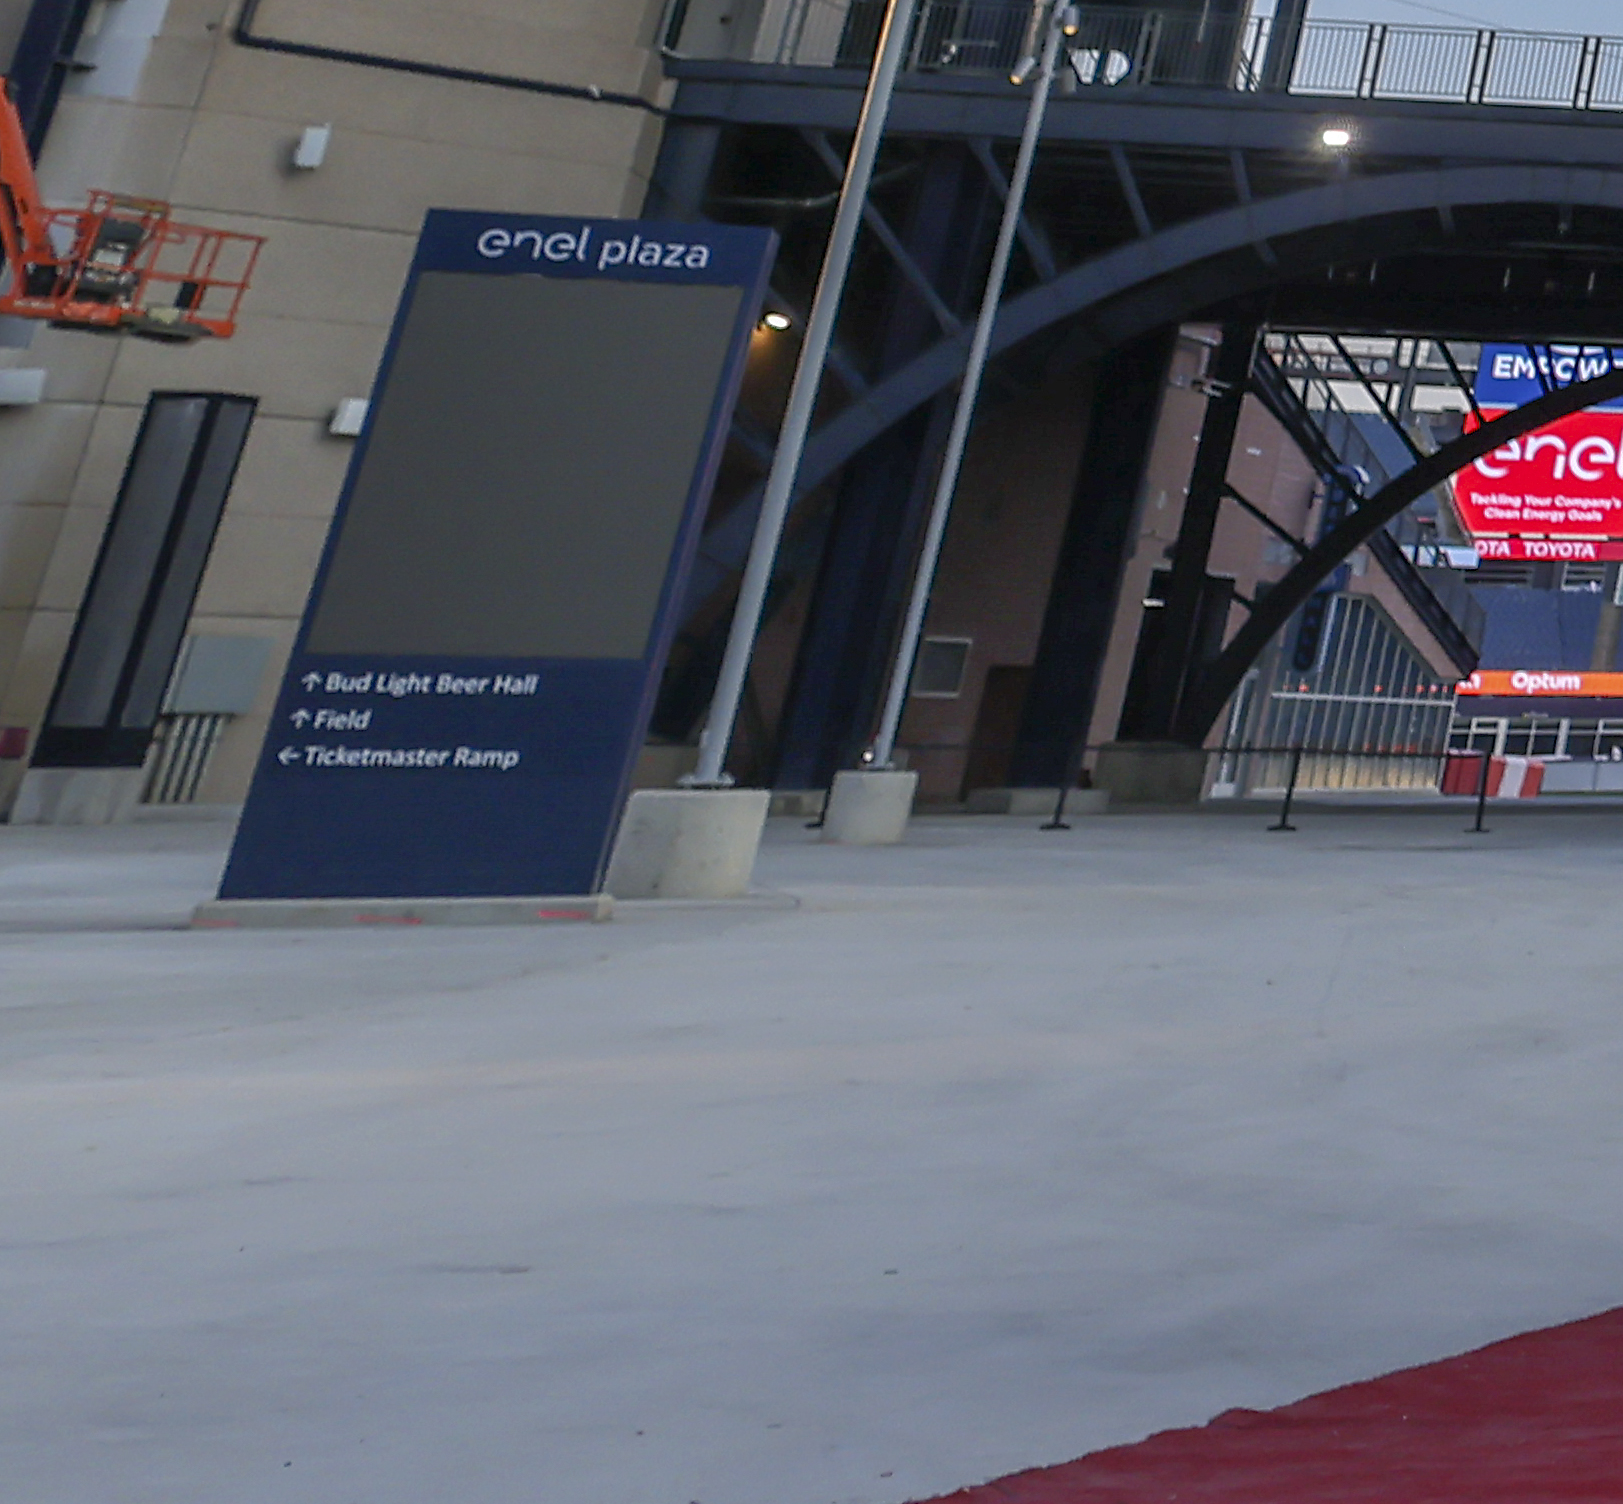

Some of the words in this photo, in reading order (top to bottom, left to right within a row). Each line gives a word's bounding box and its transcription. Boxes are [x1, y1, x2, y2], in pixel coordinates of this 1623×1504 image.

[477, 225, 592, 262] enel
[597, 235, 710, 271] plaza
[1523, 541, 1596, 559] TOYOTA
[325, 672, 373, 693] Bud
[376, 672, 432, 698] Light
[435, 673, 490, 695] Beer
[493, 674, 540, 696] Hall
[1511, 672, 1582, 694] Optum
[314, 708, 374, 731] Field
[304, 745, 450, 768] Ticketmaster
[453, 746, 521, 771] Ramp
